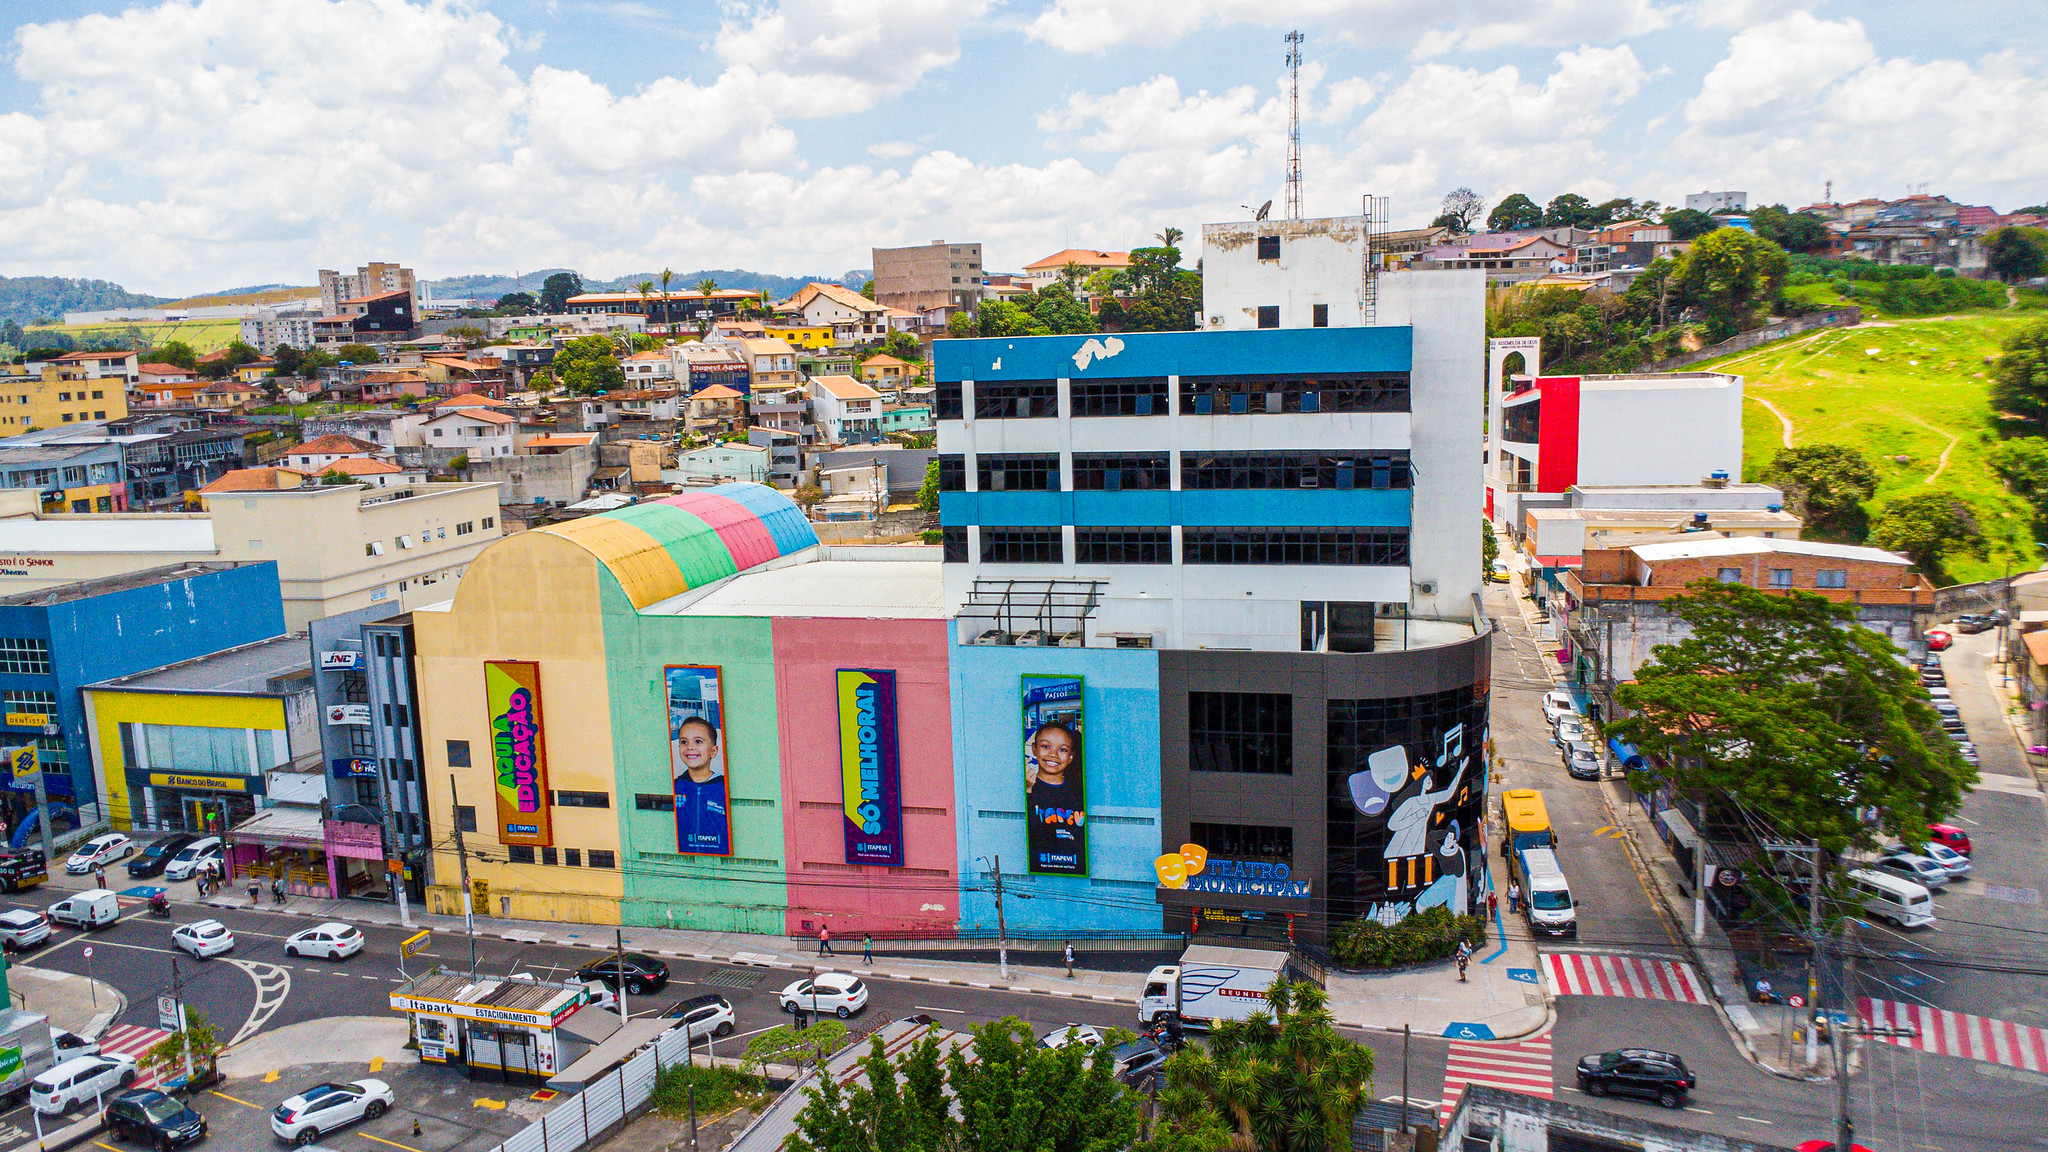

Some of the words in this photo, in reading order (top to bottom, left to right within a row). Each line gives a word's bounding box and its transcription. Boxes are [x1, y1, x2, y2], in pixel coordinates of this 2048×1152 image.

[722, 363, 747, 371] Agora
[1045, 691, 1068, 700] PASSOS
[9, 716, 47, 725] DENTISTA
[493, 716, 512, 733] A
[507, 692, 536, 813] EDUCAÇÃO
[856, 688, 880, 801] MELHORA!
[495, 735, 517, 790] AQUI
[857, 803, 882, 836] SÓ
[1051, 855, 1073, 863] ITAPEVI
[1206, 858, 1291, 880] TEATRO
[1187, 874, 1311, 899] MUNICIPAL
[410, 1000, 453, 1013] Itapark
[475, 1008, 538, 1024] ESTACIONAMENTO
